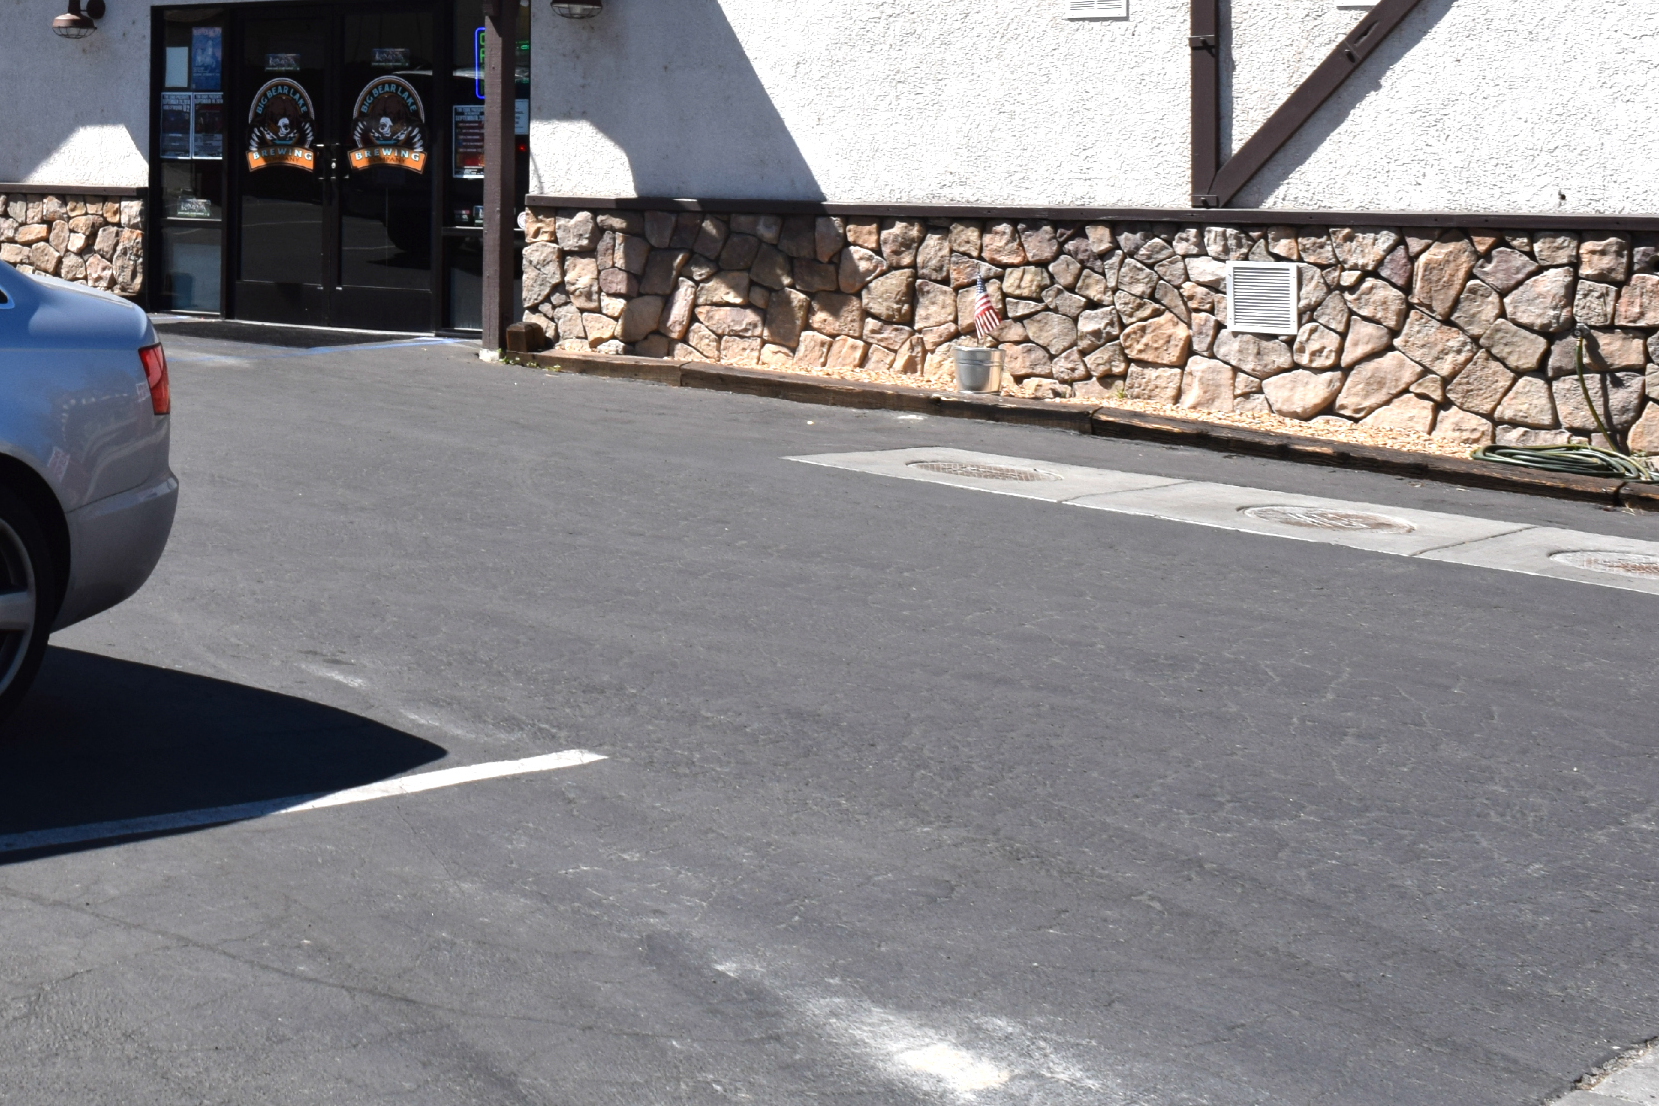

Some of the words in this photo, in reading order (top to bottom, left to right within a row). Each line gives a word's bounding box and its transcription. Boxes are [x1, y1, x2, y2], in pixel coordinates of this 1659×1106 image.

[256, 97, 268, 114] BIG
[266, 85, 288, 98] BEAR
[289, 88, 308, 113] LAKE
[361, 94, 374, 113] BIG
[372, 83, 396, 96] BEAR
[397, 87, 417, 112] LAKE
[252, 148, 313, 161] BREWING
[355, 148, 420, 161] BREWING
